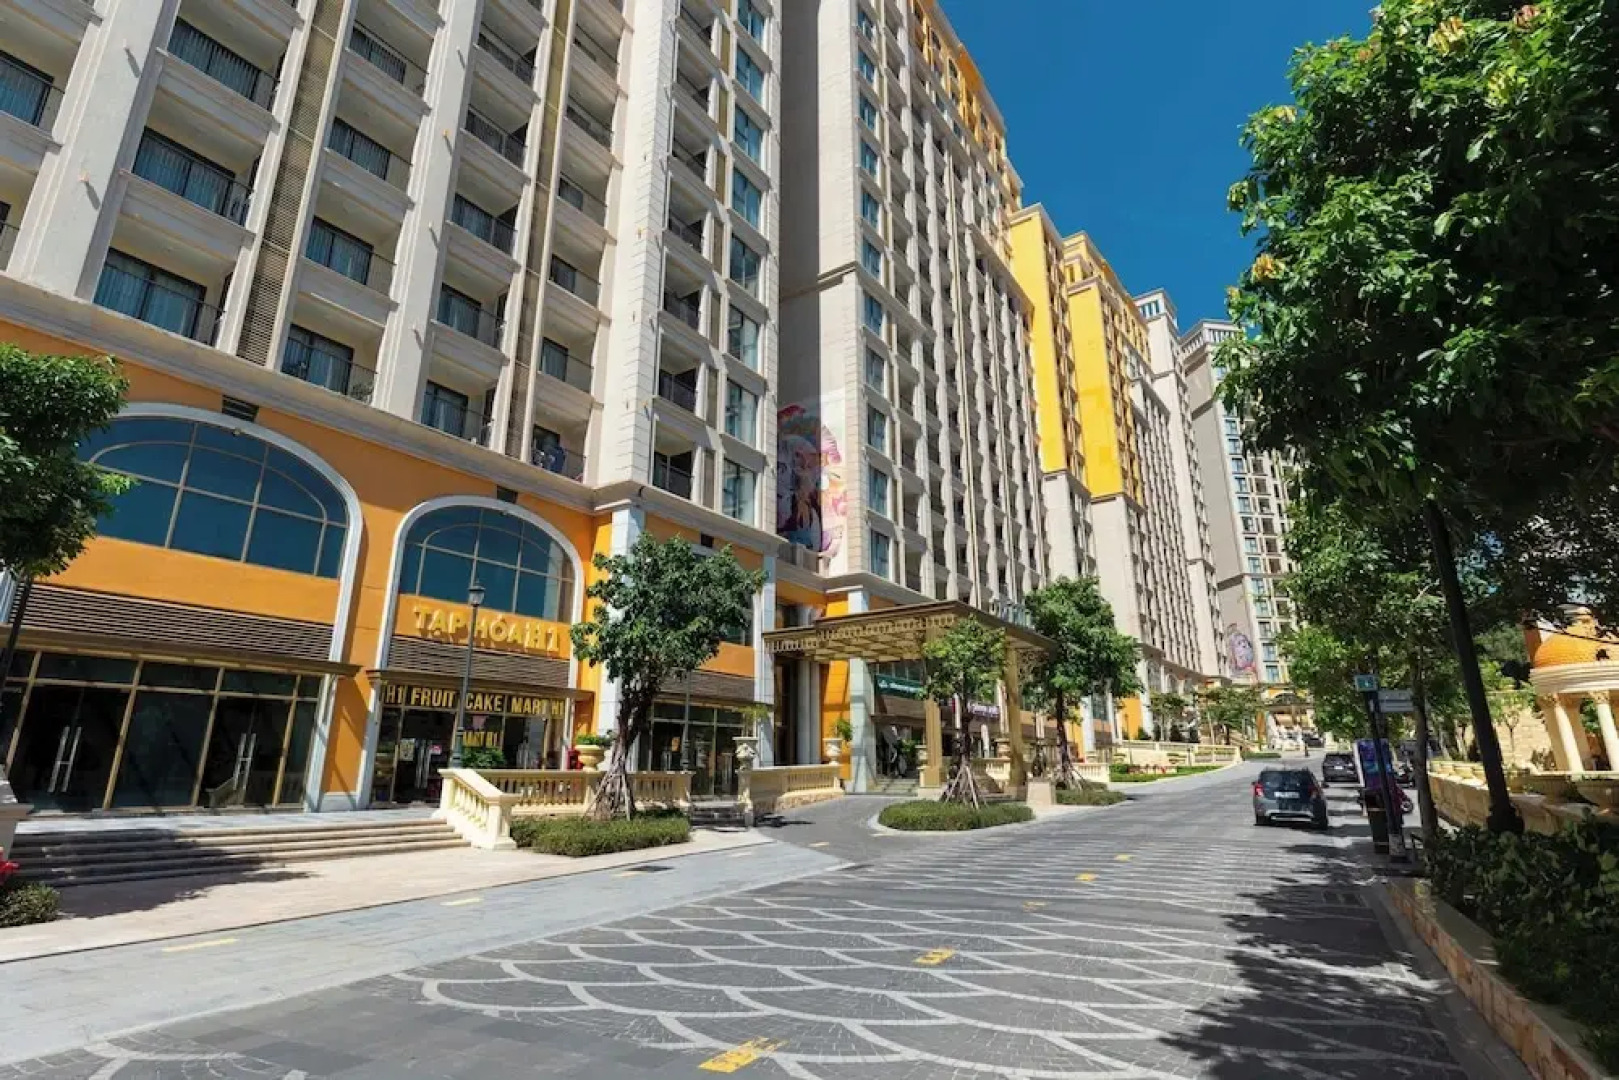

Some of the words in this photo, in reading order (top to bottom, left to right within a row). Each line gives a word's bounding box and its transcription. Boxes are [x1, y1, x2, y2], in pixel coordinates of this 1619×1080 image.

[411, 687, 456, 707] FRUIT
[465, 692, 503, 712] CAKE
[511, 697, 548, 715] MART
